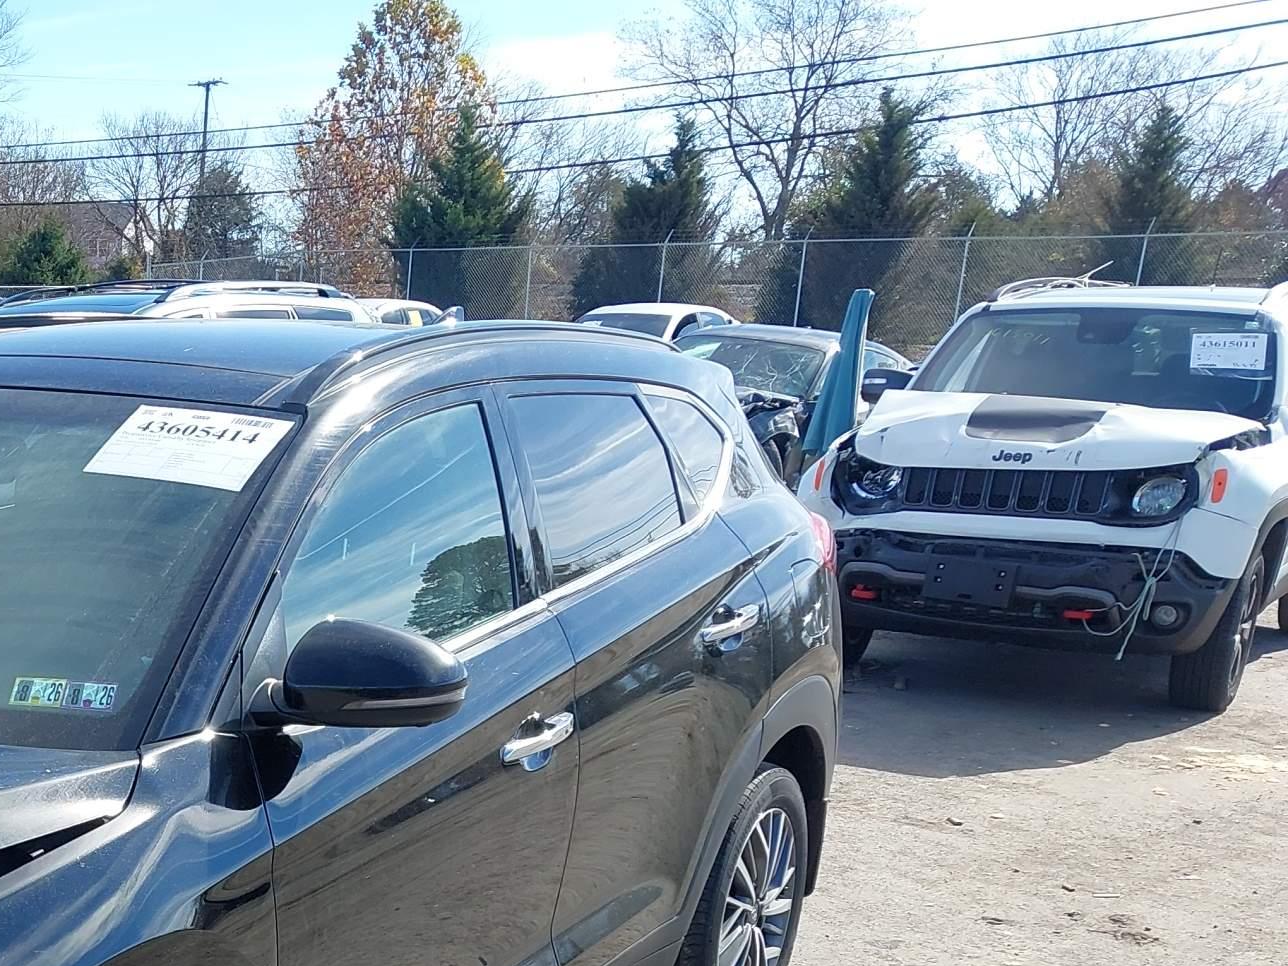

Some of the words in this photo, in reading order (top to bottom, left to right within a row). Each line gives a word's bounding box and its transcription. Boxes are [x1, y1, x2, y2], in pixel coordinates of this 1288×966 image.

[1199, 340, 1257, 349] 43615011
[136, 420, 261, 445] 43605414
[992, 449, 1033, 464] Jeep
